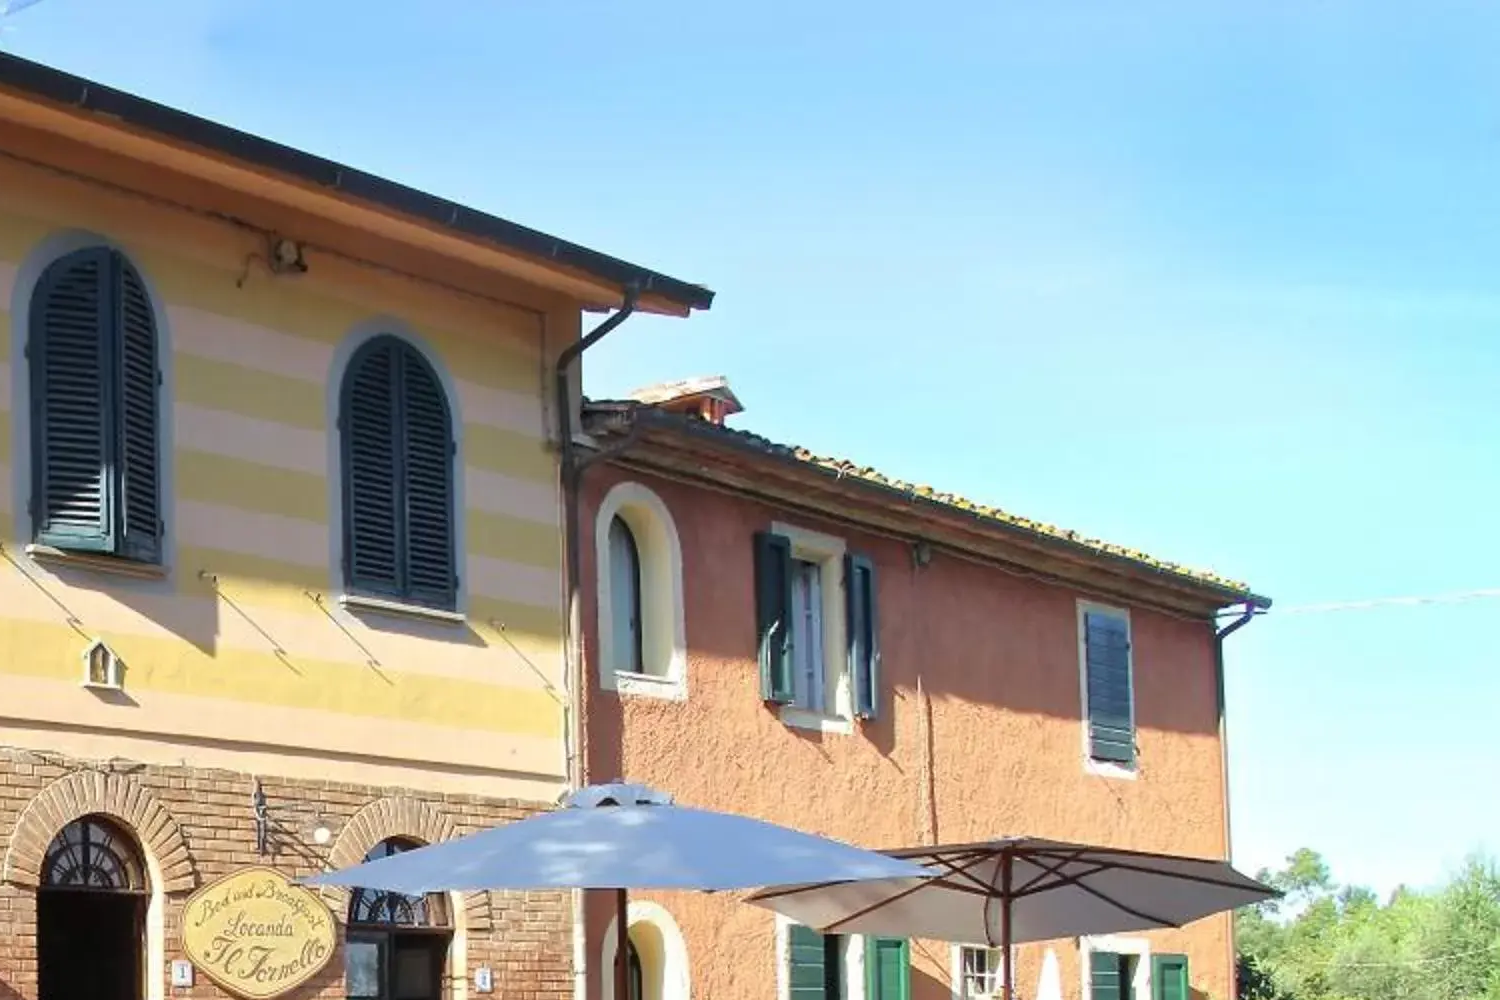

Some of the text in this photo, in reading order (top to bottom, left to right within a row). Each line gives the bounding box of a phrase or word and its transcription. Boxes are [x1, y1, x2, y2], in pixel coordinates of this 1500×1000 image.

[195, 879, 326, 931] Bed and Breakfast
[223, 910, 294, 937] Locanda
[203, 935, 241, 976] Il
